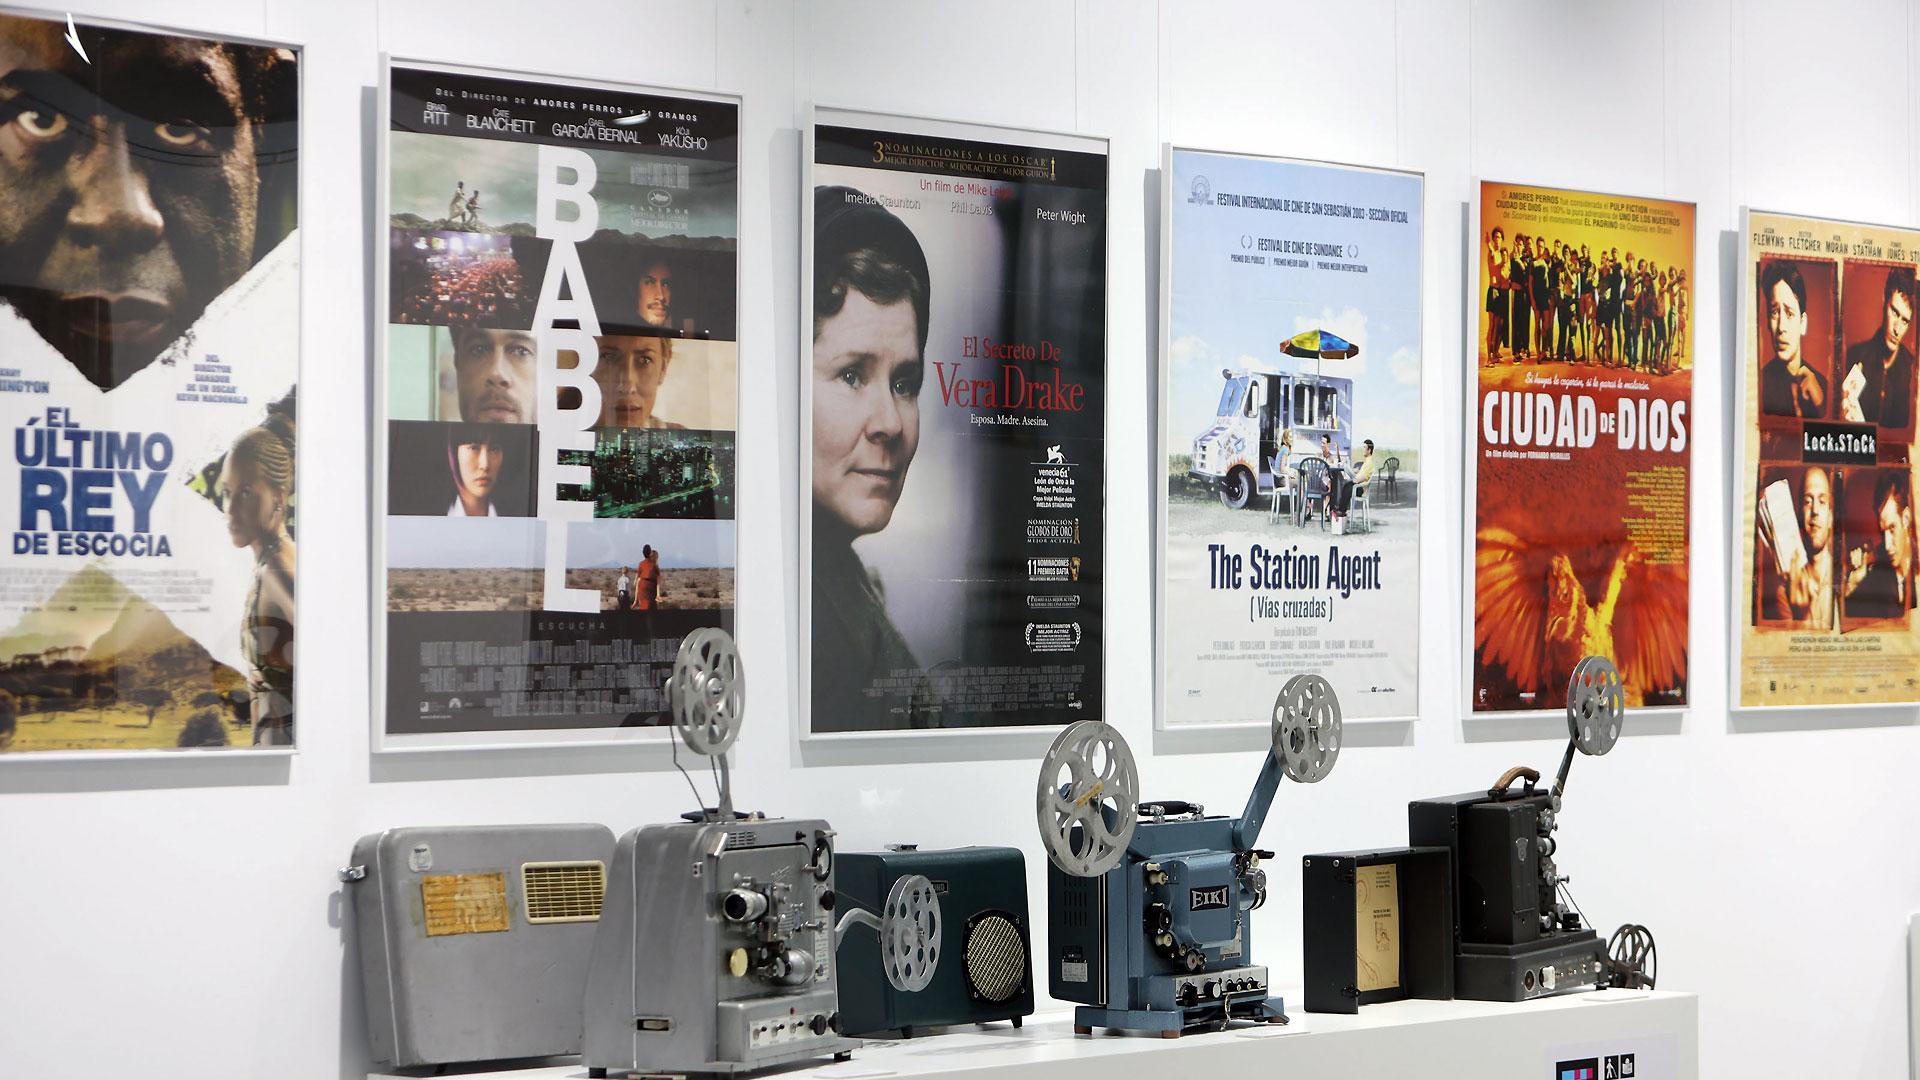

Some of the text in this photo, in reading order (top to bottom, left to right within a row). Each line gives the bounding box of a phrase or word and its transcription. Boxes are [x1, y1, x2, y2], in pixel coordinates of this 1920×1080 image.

[426, 101, 448, 112] BRAD
[462, 90, 508, 103] DIRECTOR
[515, 97, 527, 105] DE
[533, 98, 576, 110] AMORES
[582, 103, 623, 114] PERROS
[658, 111, 698, 122] GRAMOS
[492, 108, 511, 118] CATE
[423, 110, 451, 126] PITT
[466, 114, 537, 134] BLANCHETT
[588, 117, 606, 128] GAEL
[551, 123, 642, 144] GARCÍA BERNAL
[658, 133, 708, 150] YAKUSHO
[872, 141, 884, 163] 3
[885, 143, 972, 159] NOMINACIONES
[977, 152, 984, 161] A
[988, 153, 1007, 163] LOS
[884, 156, 907, 166] MEJOR
[908, 157, 945, 169] DIRECTOR
[950, 162, 972, 171] MEJOR
[973, 164, 998, 174] ACTRIZ
[1003, 167, 1025, 177] MEJOR
[920, 179, 932, 191] Un
[934, 180, 952, 194] film
[953, 182, 965, 194] de
[967, 184, 987, 196] Mike
[844, 191, 922, 210] Imelda Staunton
[950, 200, 993, 216] Phil Davis
[1217, 192, 1241, 207] FESTIVAL
[1242, 195, 1283, 211] INTERNACIONAL
[1284, 199, 1290, 212] DE
[1291, 200, 1303, 213] CINE
[1304, 201, 1311, 214] DE
[1311, 202, 1323, 215] SAN
[1390, 210, 1408, 223] OFICIAL
[1508, 192, 1648, 214] AMORES PERROS PULP FICTION
[1036, 208, 1087, 225] Peter Wight
[1496, 200, 1518, 210] CIUDAD
[1518, 202, 1527, 211] DE
[1527, 203, 1542, 212] DIOS
[1619, 212, 1631, 221] UNO
[1631, 213, 1639, 222] DE
[1640, 214, 1651, 223] LOS
[1651, 215, 1680, 227] NUESTROS
[1584, 218, 1618, 229] EL PADRINO
[1258, 238, 1343, 258] FESTIVAL DE CINE DE SUNDANCE
[1789, 236, 1821, 251] FLETCHER
[1826, 240, 1848, 254] MORAN
[1853, 244, 1882, 258] STATHAM
[1887, 246, 1905, 260] JONES
[963, 336, 1063, 363] El Secreto De
[531, 144, 602, 614] BABEL
[932, 361, 1085, 412] Vera Drake
[46, 407, 80, 428] EL
[970, 413, 1049, 427] Esposa. Madre. Asesina.
[1483, 390, 1686, 453] CIUDAD DE DIOS
[15, 416, 174, 471] ÚLTIMO
[1036, 486, 1052, 494] Mejor
[1047, 477, 1054, 485] de
[20, 468, 168, 533] REY
[1027, 526, 1073, 537] GLOBOS DE ORO
[13, 532, 172, 557] DE ESCOCIA
[1208, 544, 1381, 599] The Station Agent
[538, 622, 606, 631] ESCUCHA
[1192, 887, 1228, 909] EIKI
